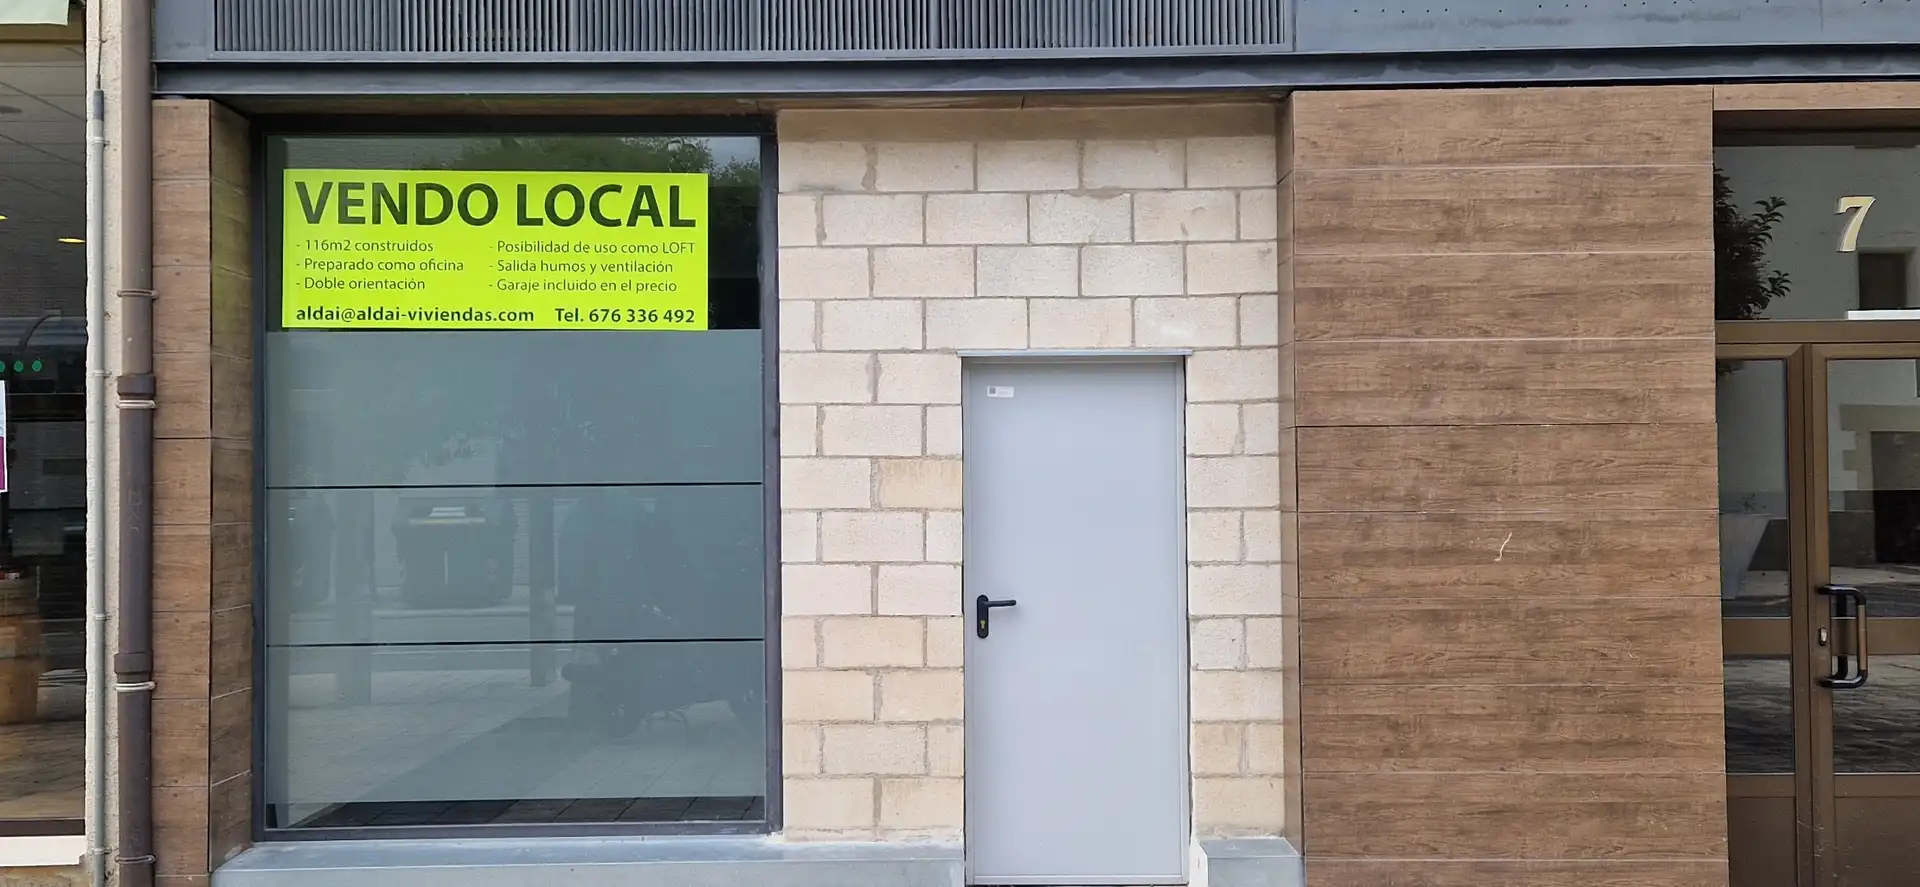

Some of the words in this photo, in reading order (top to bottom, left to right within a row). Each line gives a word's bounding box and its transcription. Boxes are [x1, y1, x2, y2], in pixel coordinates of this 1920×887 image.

[295, 181, 499, 226] VENDO
[516, 183, 697, 228] LOCAL
[1837, 195, 1876, 252] 7
[305, 239, 351, 252] 116m2
[354, 239, 434, 252] construidos
[496, 240, 570, 254] Posibilidad
[573, 240, 591, 254] de
[594, 244, 618, 254] uso
[620, 244, 659, 254] como
[662, 241, 696, 254] LOFT
[304, 258, 374, 274] Preparado
[377, 260, 416, 271] como
[419, 258, 464, 271] oficina
[496, 259, 537, 272] Salida
[540, 259, 587, 273] humos
[589, 263, 598, 275] y
[600, 260, 673, 273] ventilación
[304, 277, 345, 290] Doble
[348, 277, 425, 290] orientación
[496, 278, 540, 293] Garaje
[542, 278, 597, 292] incluido
[600, 282, 617, 292] en
[620, 279, 632, 292] el
[635, 280, 677, 294] precio
[296, 305, 535, 323] aldai@aldai-viviendas.com
[554, 307, 585, 323] Tel.
[588, 308, 621, 323] 676
[626, 308, 659, 323] 336
[662, 309, 696, 324] 492
